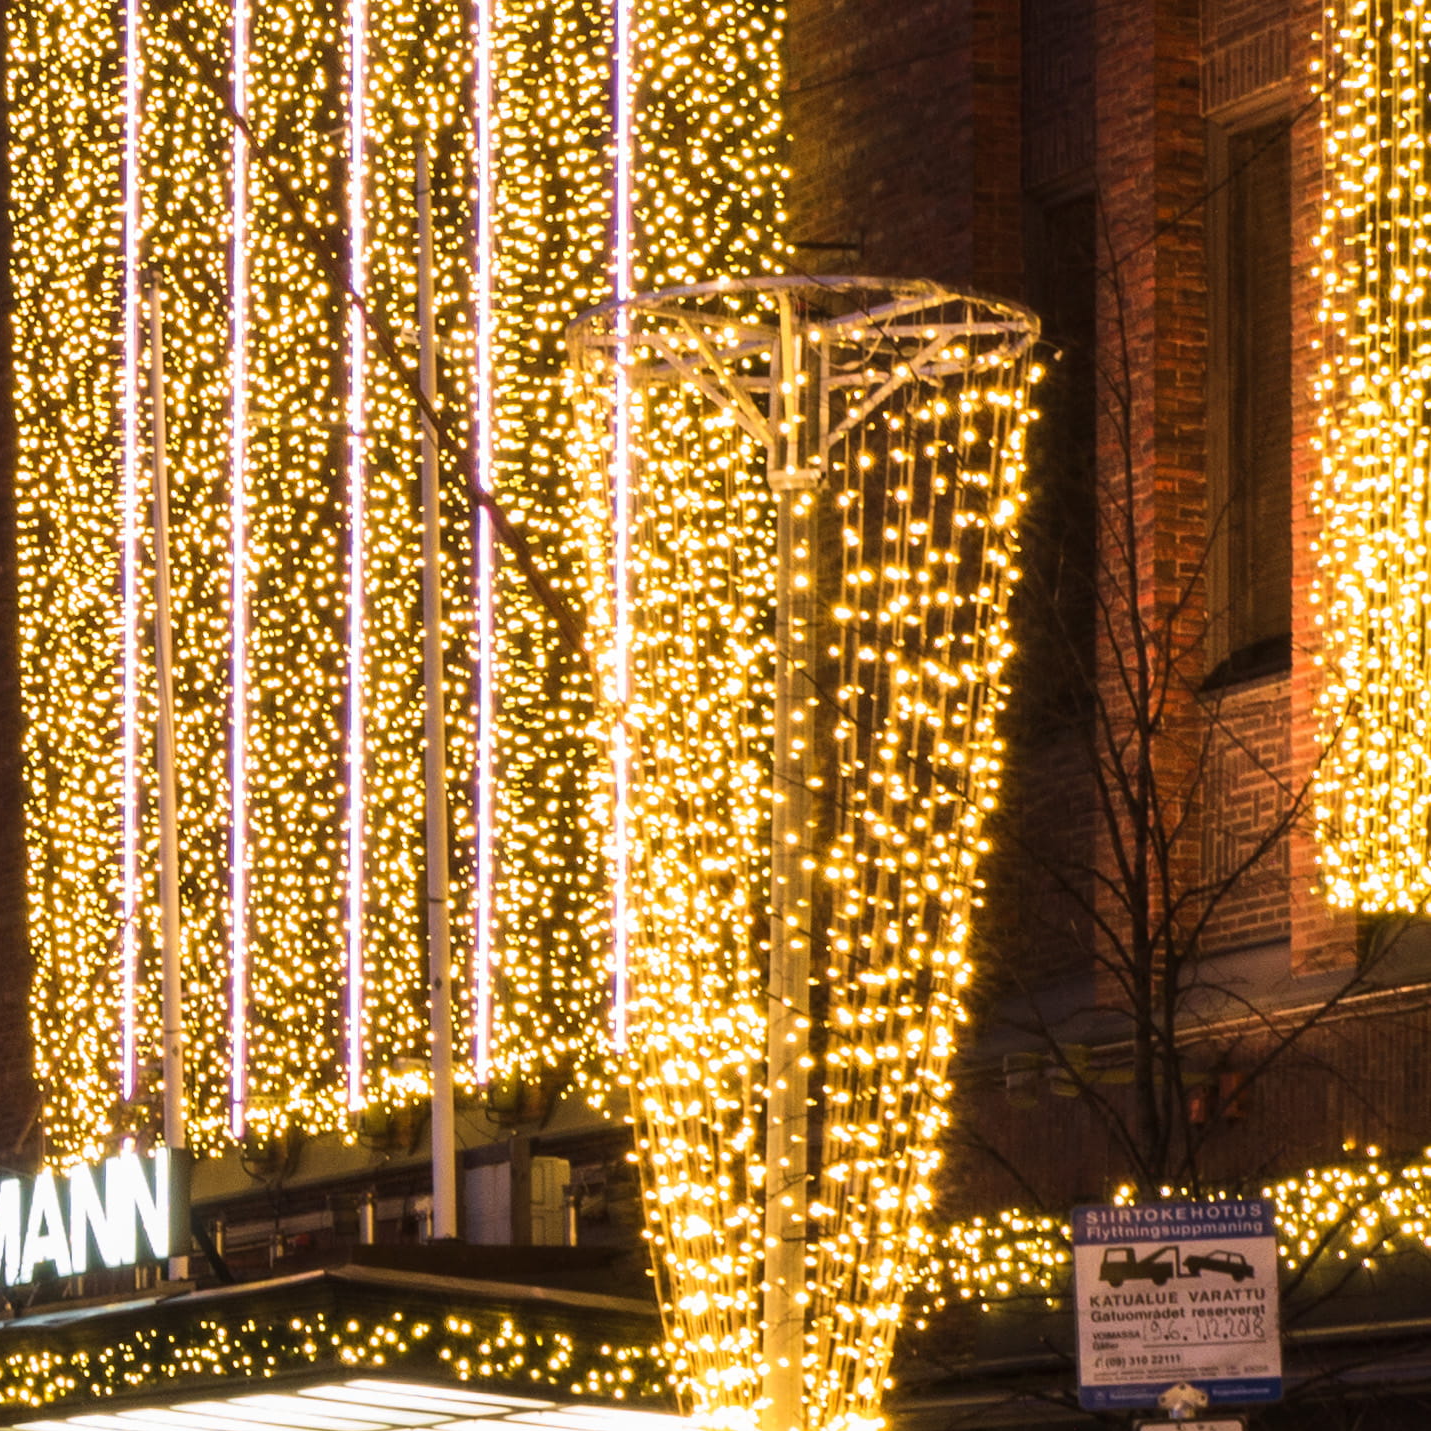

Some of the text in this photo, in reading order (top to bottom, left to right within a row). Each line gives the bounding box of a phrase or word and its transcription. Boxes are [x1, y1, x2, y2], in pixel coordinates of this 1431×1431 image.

[1085, 1204, 1263, 1225] SIIRTOKEHOTUS
[1087, 1220, 1264, 1241] Flyttningsuppmaning
[1089, 1288, 1266, 1308] KATUALUE VARATTU
[1091, 1306, 1186, 1323] Gatuområdet
